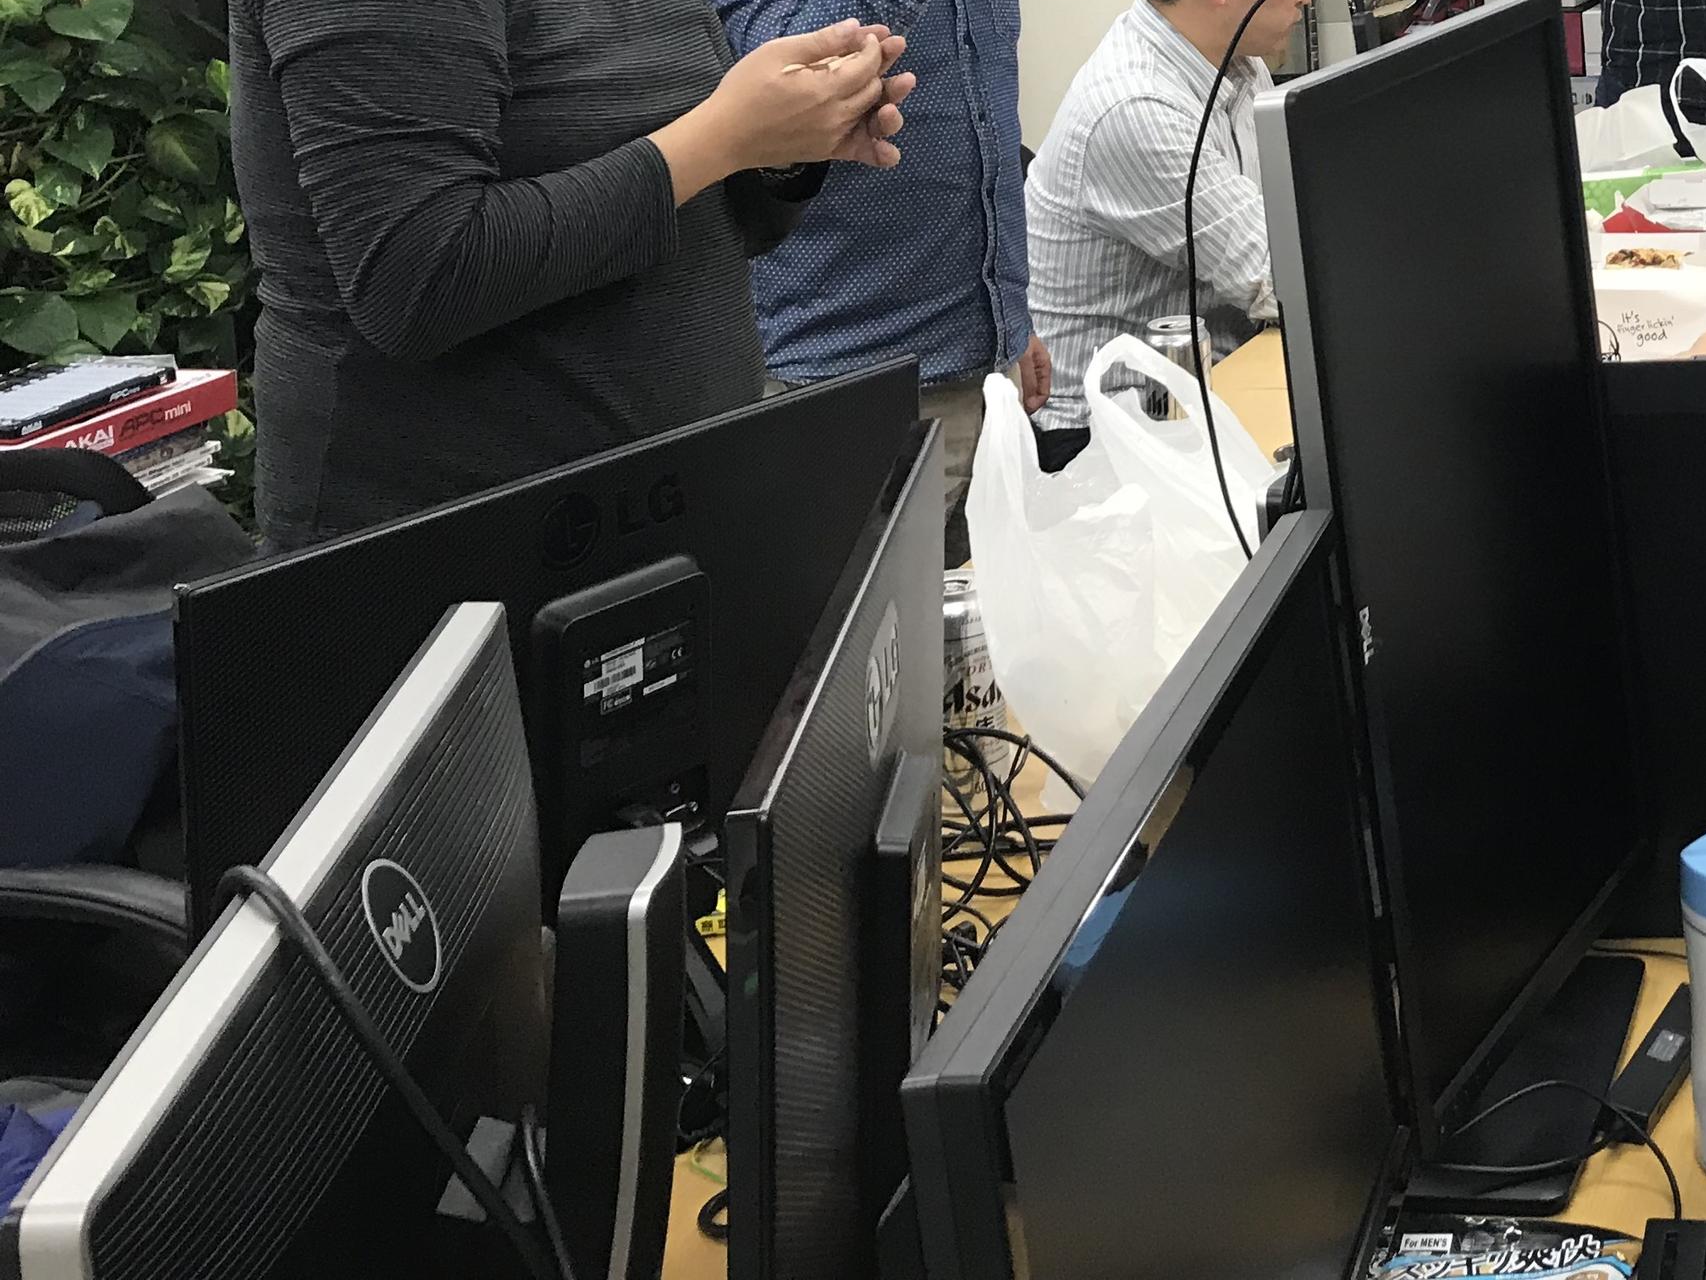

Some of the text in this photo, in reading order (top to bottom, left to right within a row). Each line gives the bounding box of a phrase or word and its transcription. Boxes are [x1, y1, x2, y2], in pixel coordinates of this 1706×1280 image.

[1621, 310, 1641, 324] It's
[1636, 328, 1668, 348] good
[164, 401, 193, 421] mini
[64, 424, 115, 450] AKAI
[1359, 606, 1375, 667] DELL
[382, 891, 426, 960] DELL
[1404, 1237, 1448, 1249] For MEN'S
